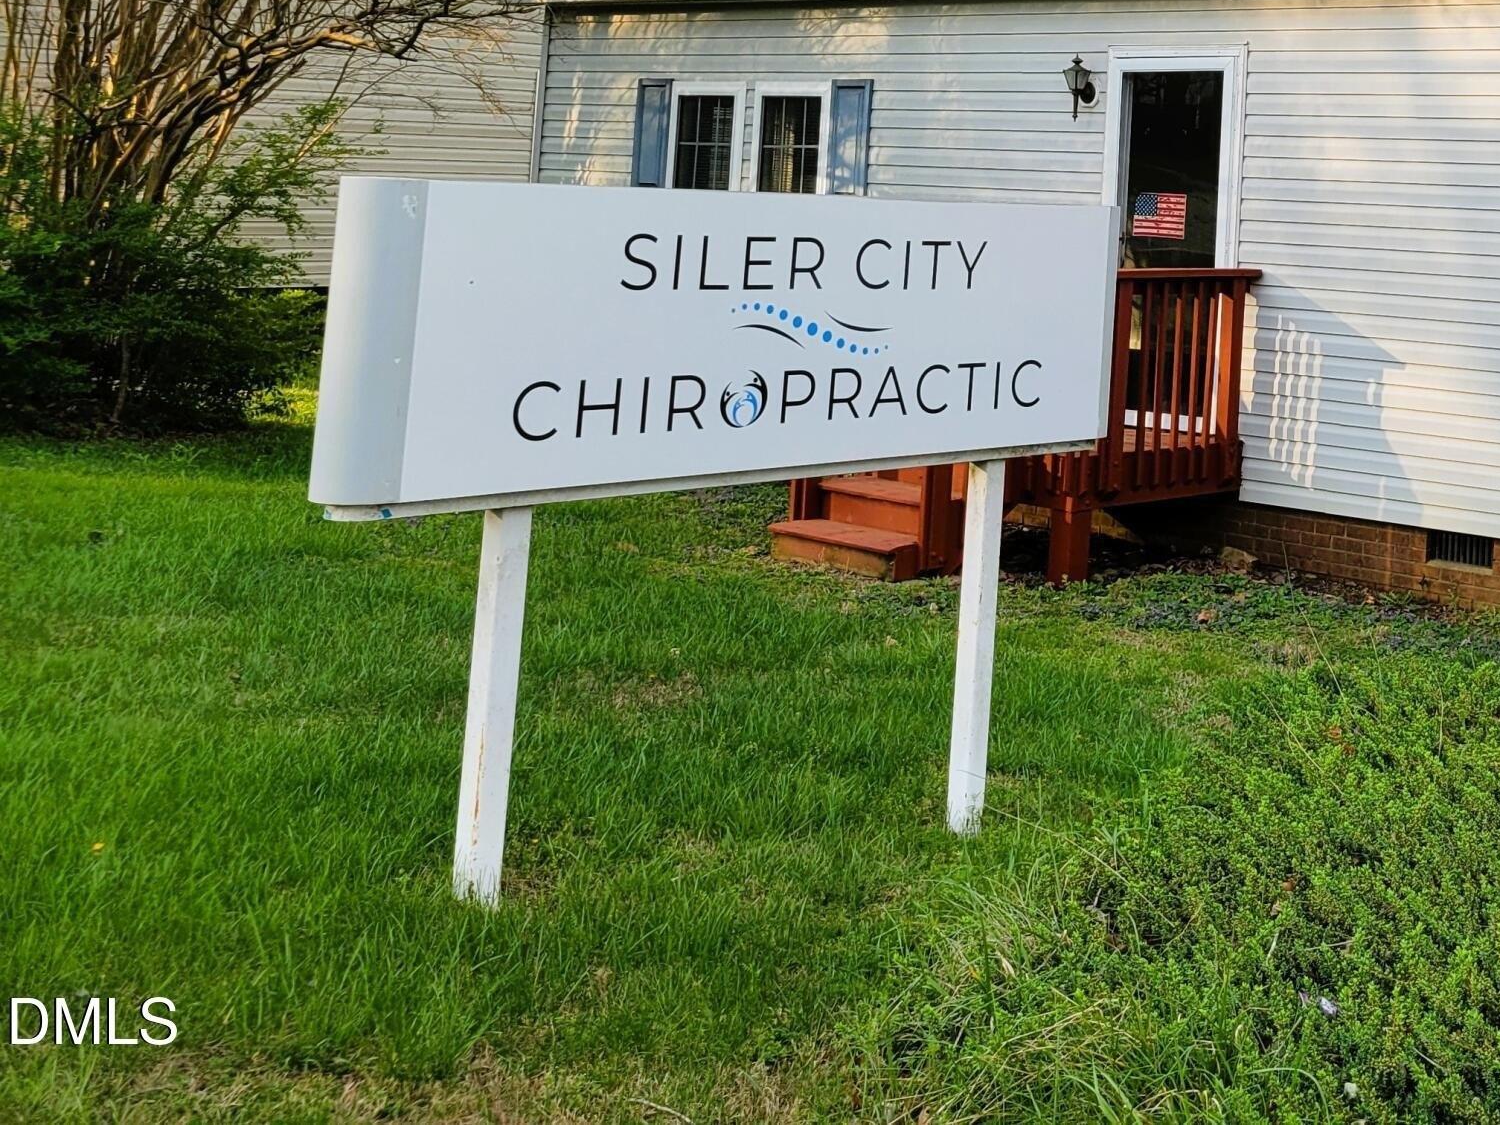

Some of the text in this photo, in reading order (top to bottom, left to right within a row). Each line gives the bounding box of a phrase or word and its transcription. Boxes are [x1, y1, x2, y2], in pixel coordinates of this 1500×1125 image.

[620, 233, 988, 291] SILER CITY
[512, 359, 1042, 442] CHIROPRACTIC
